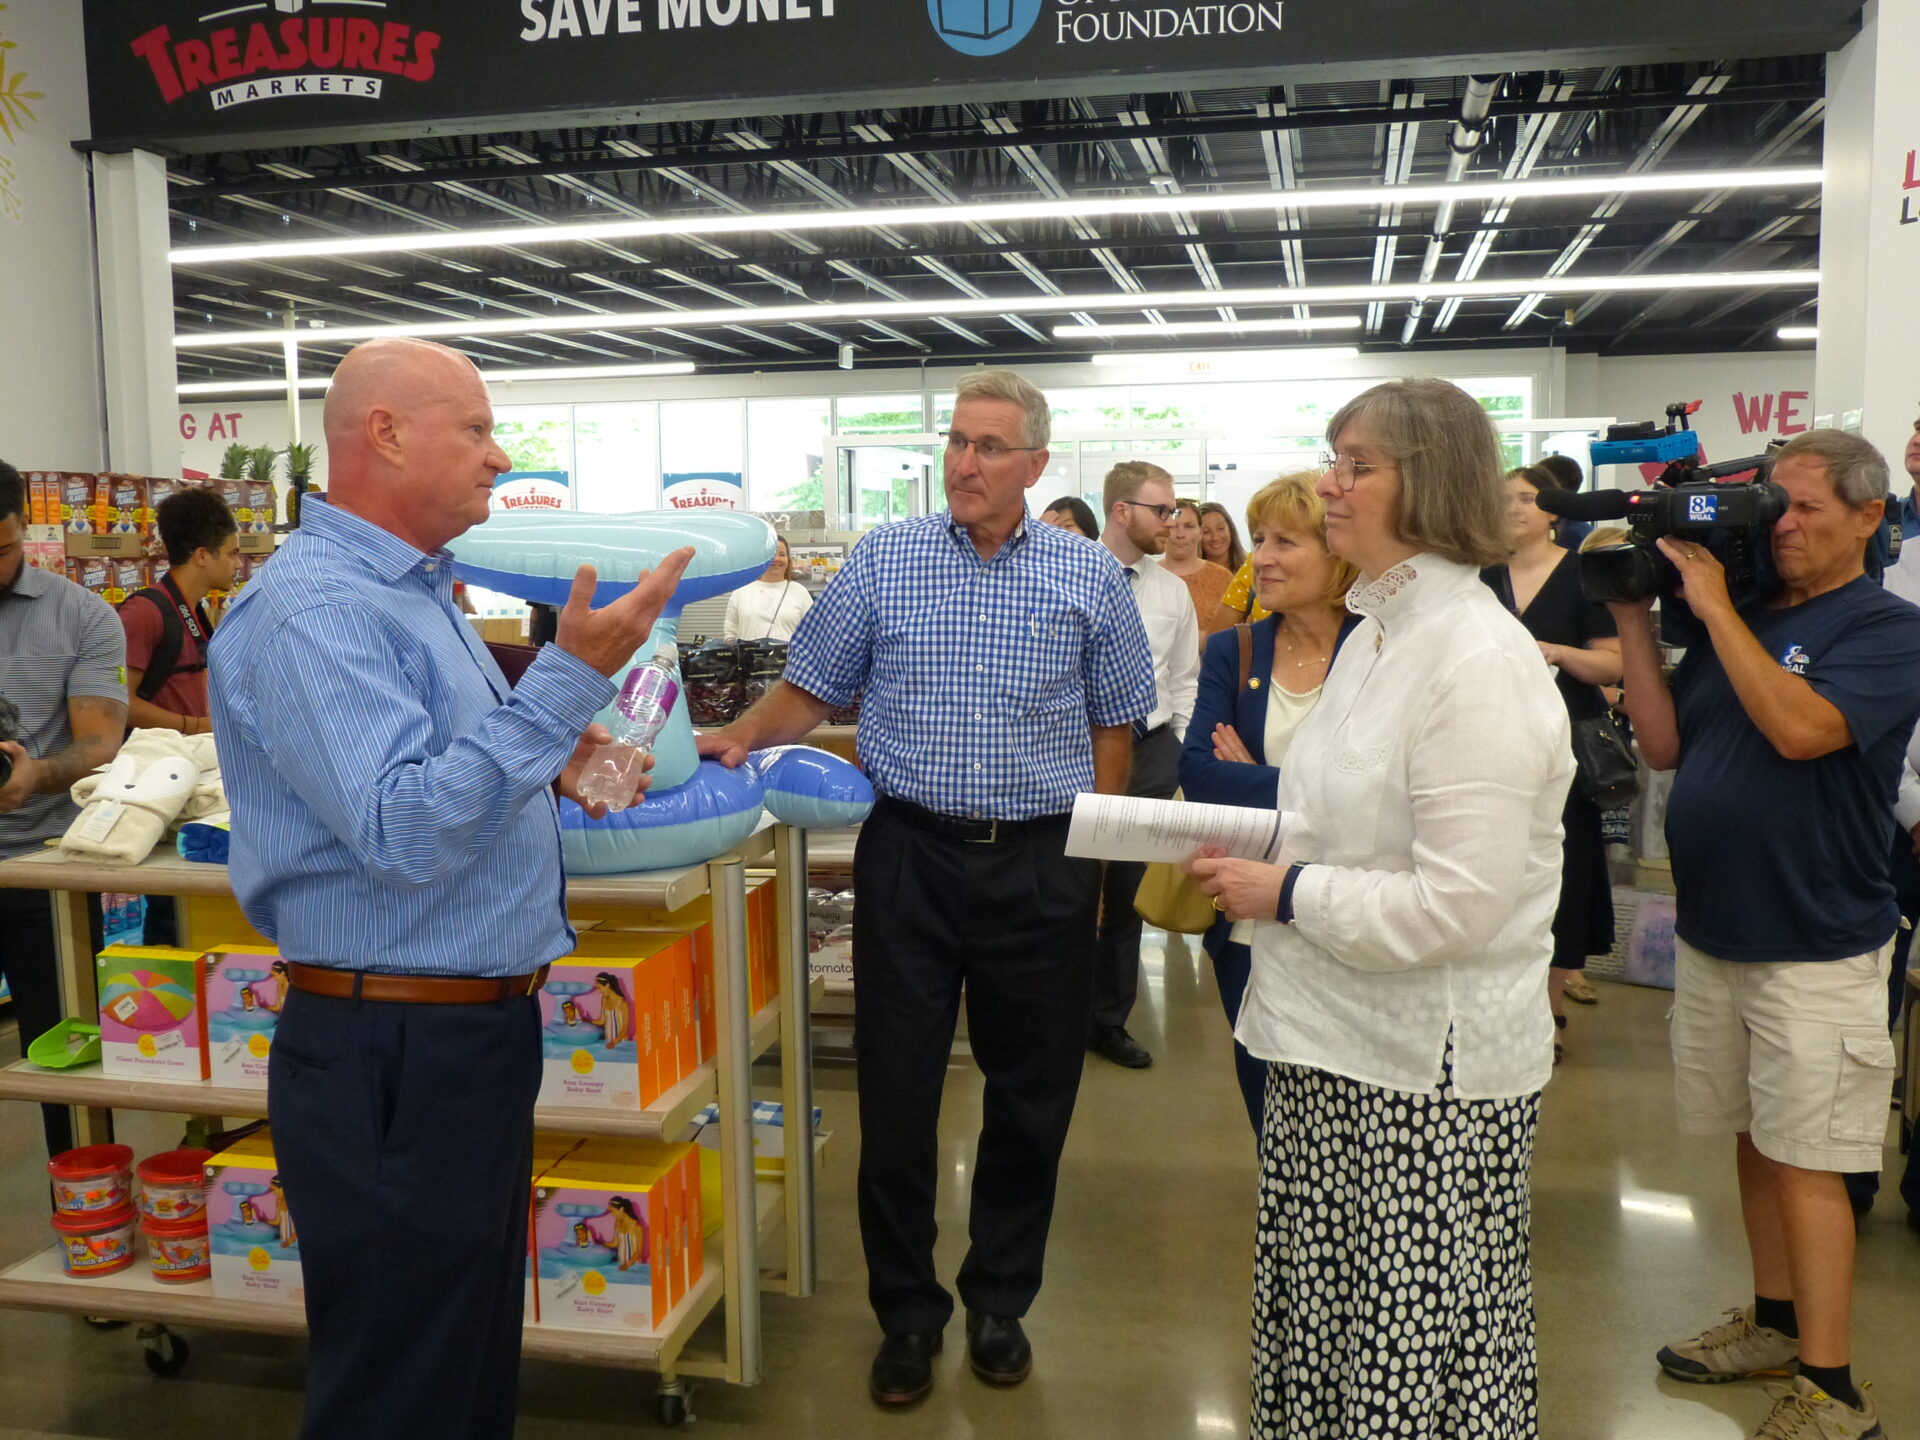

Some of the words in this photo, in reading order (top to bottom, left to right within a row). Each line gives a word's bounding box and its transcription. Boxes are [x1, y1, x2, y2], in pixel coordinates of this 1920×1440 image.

[520, 0, 641, 42] SAVE
[1055, 1, 1284, 44] FOUNDATION
[130, 17, 442, 104] TREASURES
[217, 77, 377, 106] MARKETS
[208, 412, 243, 441] AT
[500, 495, 562, 509] TREASURES
[1690, 512, 1713, 521] WGAL
[1691, 496, 1704, 513] 8
[809, 963, 853, 973] tomato
